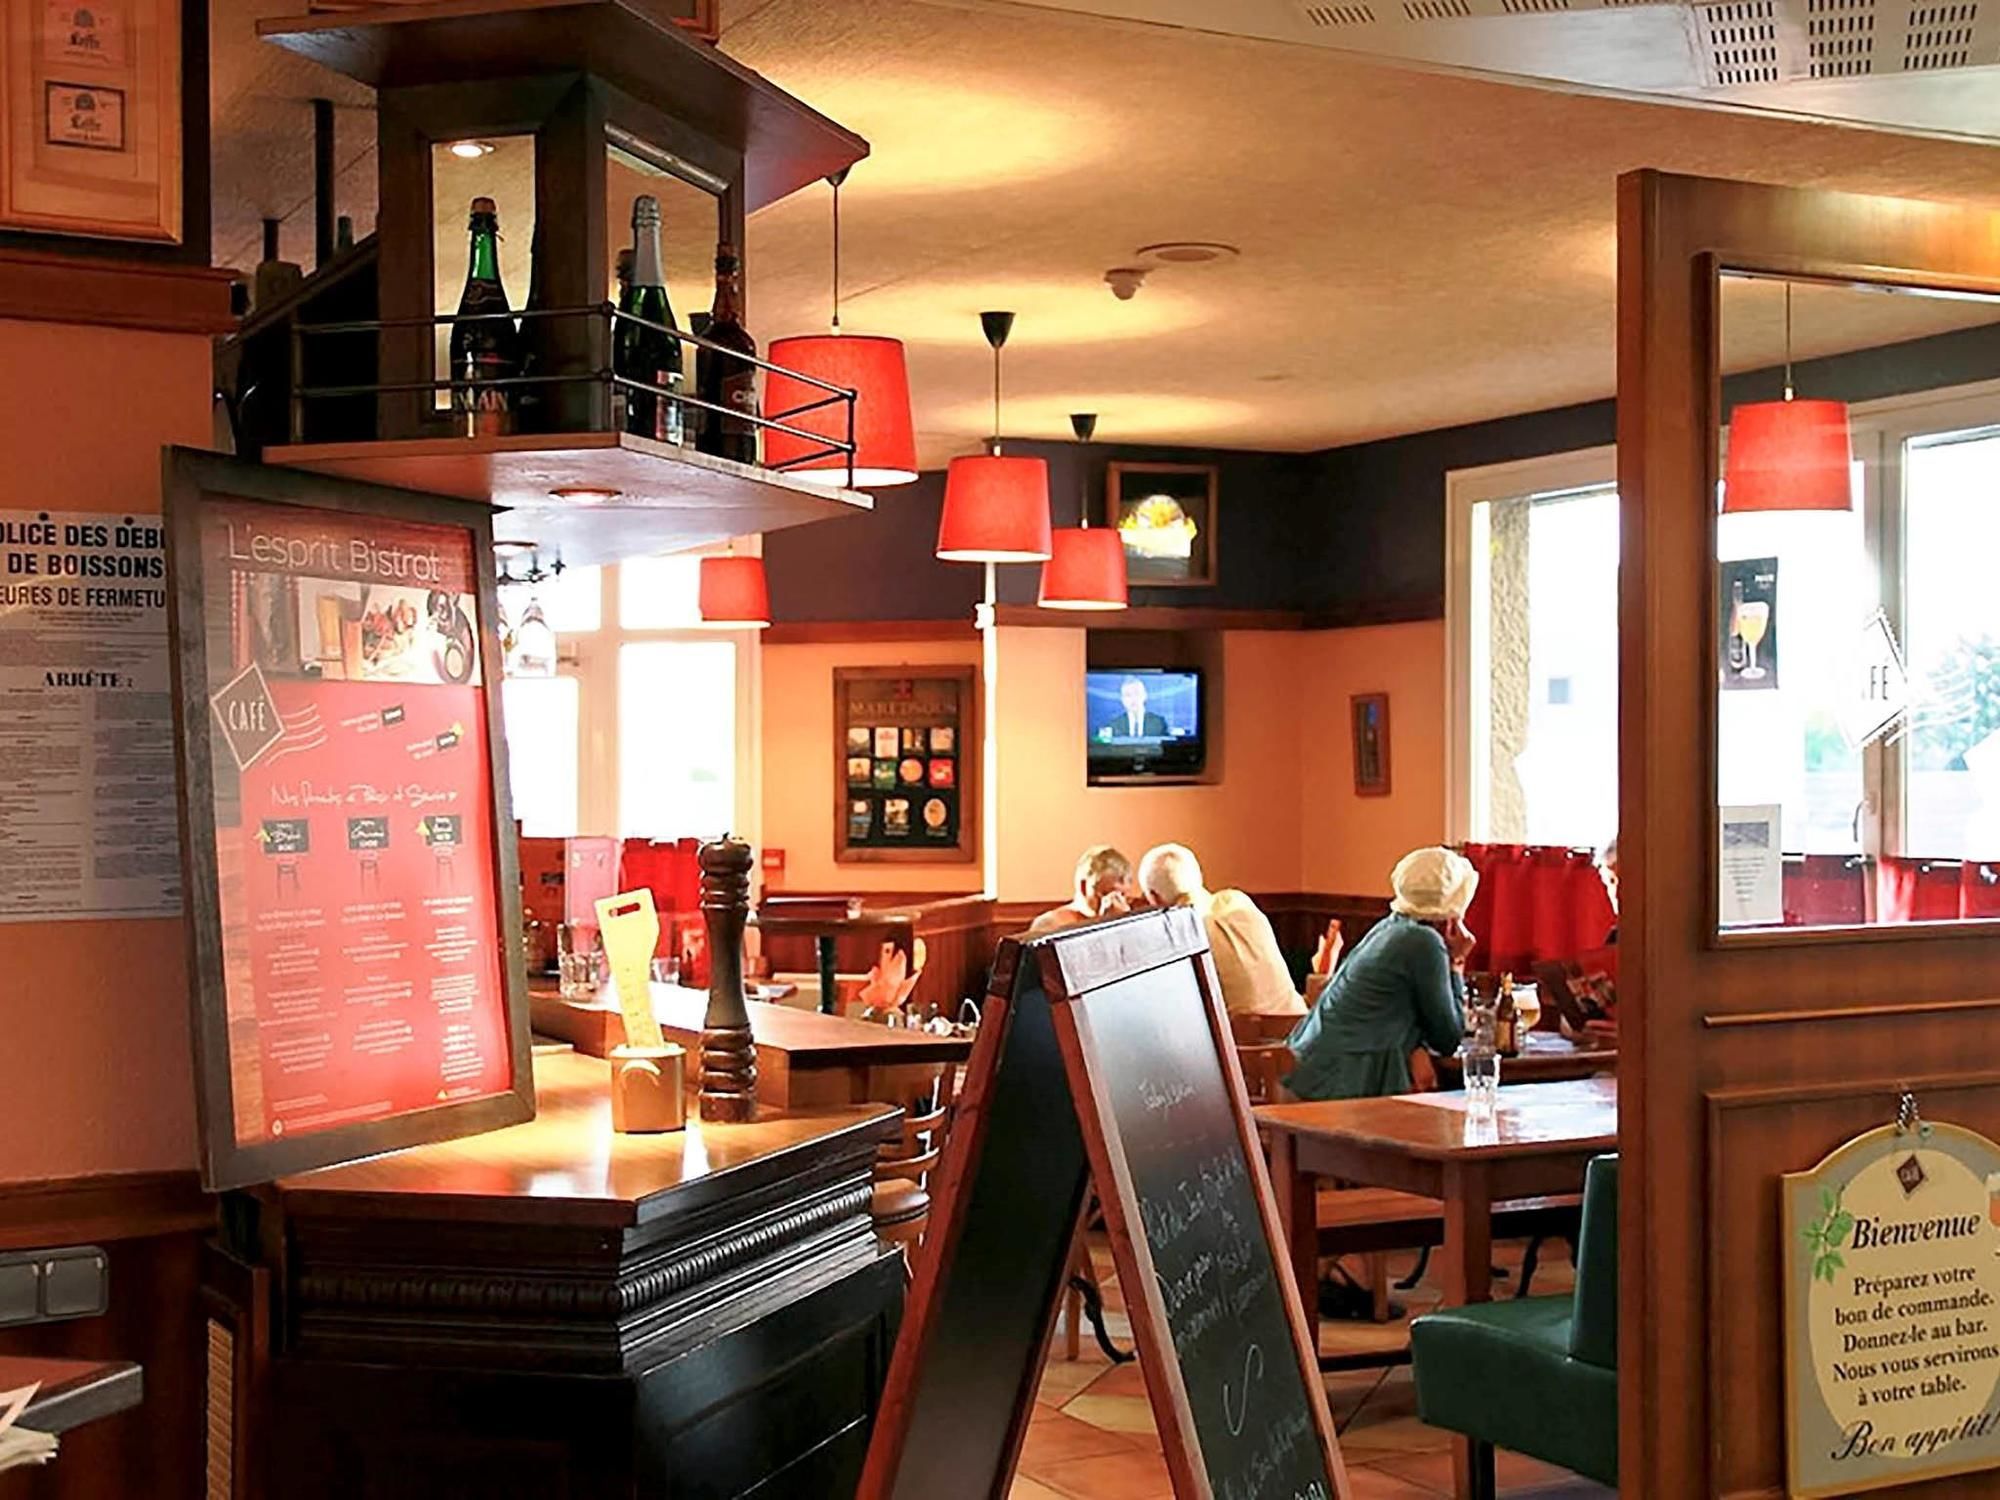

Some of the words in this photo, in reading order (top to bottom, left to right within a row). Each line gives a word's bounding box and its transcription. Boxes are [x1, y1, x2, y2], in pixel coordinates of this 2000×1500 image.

[65, 525, 108, 547] DES
[228, 523, 341, 571] L'esprit
[350, 539, 440, 581] Bistrot
[8, 553, 38, 574] DE
[47, 554, 163, 578] BOISSONS
[58, 587, 80, 606] DE
[228, 695, 267, 732] CAFÉ
[1851, 1214, 1981, 1250] Bienvenue
[1853, 1272, 1930, 1298] Préparez
[1933, 1266, 1976, 1285] votre
[1834, 1306, 1868, 1326] bon
[1871, 1300, 1894, 1321] de
[1897, 1287, 1995, 1318] commande.
[1843, 1324, 1928, 1353] Donnez-le
[1931, 1324, 1952, 1341] au
[1955, 1316, 1988, 1336] bar.
[1832, 1362, 1877, 1383] Nous
[1880, 1356, 1920, 1375] vous
[1923, 1343, 2000, 1369] servirons
[1857, 1386, 1868, 1406] à
[1871, 1383, 1916, 1403] votre
[1920, 1373, 1967, 1397] table.
[1831, 1419, 1896, 1461] Bon
